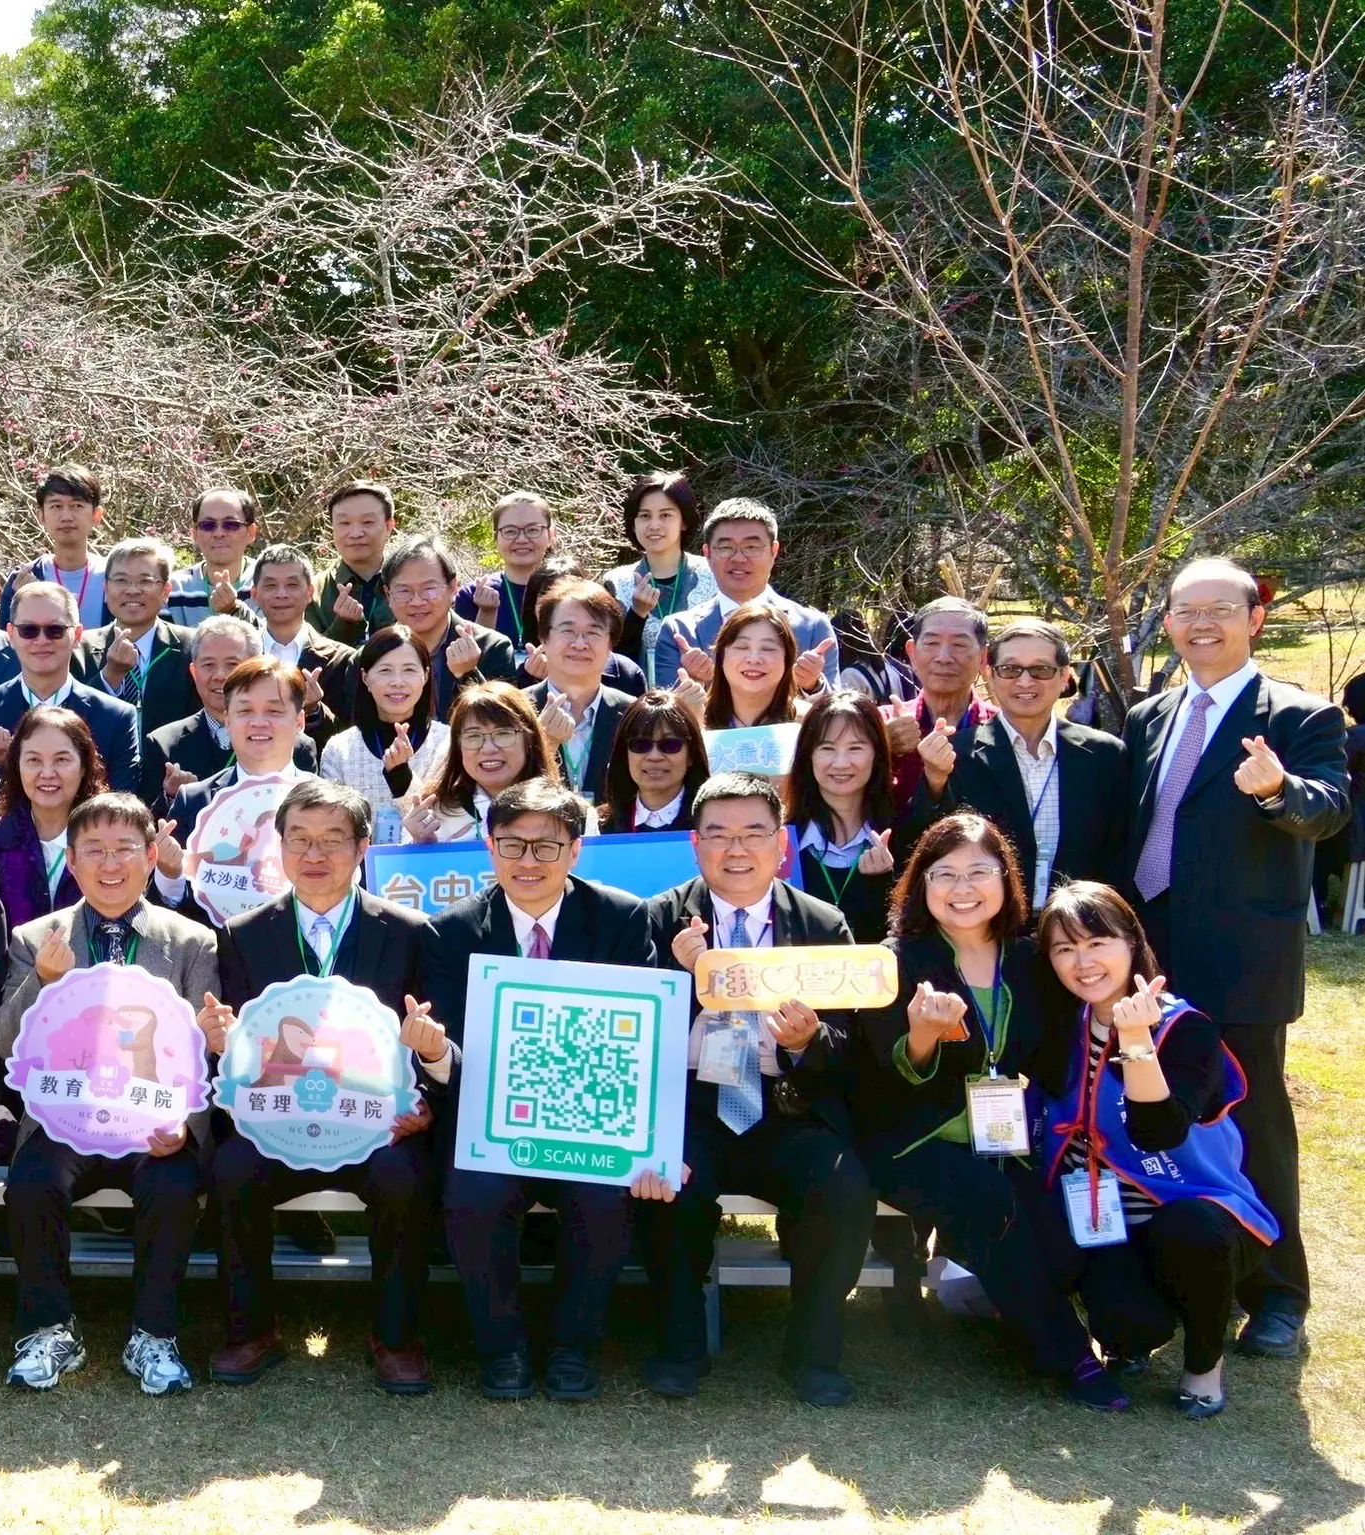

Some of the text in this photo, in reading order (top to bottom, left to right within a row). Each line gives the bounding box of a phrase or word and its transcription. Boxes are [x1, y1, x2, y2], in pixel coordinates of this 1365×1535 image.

[202, 868, 249, 891] 水沙連
[381, 872, 500, 910] 台中
[40, 1075, 173, 1109] 教育 學院
[249, 1092, 292, 1113] 管理
[338, 1097, 383, 1119] 學院
[543, 1149, 615, 1169] SCAN ME
